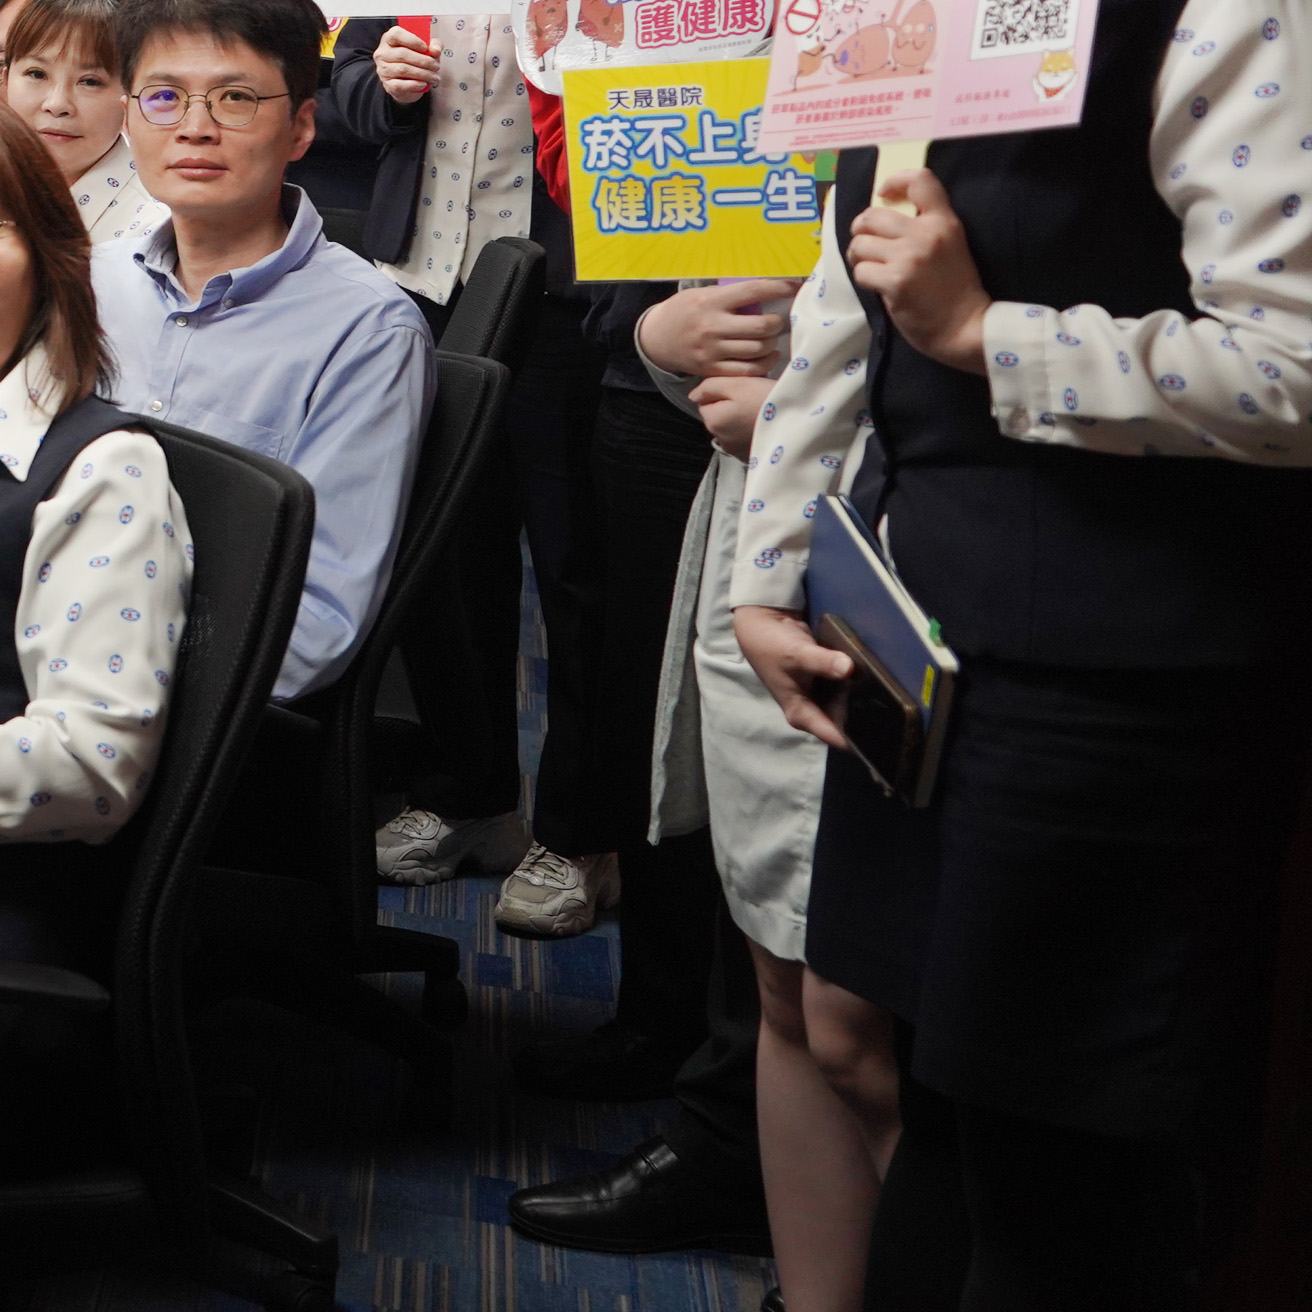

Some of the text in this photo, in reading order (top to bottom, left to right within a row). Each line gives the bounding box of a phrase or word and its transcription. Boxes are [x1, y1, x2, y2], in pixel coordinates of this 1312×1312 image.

[608, 86, 703, 111] 天晟醫院
[591, 168, 820, 236] 健康一生
